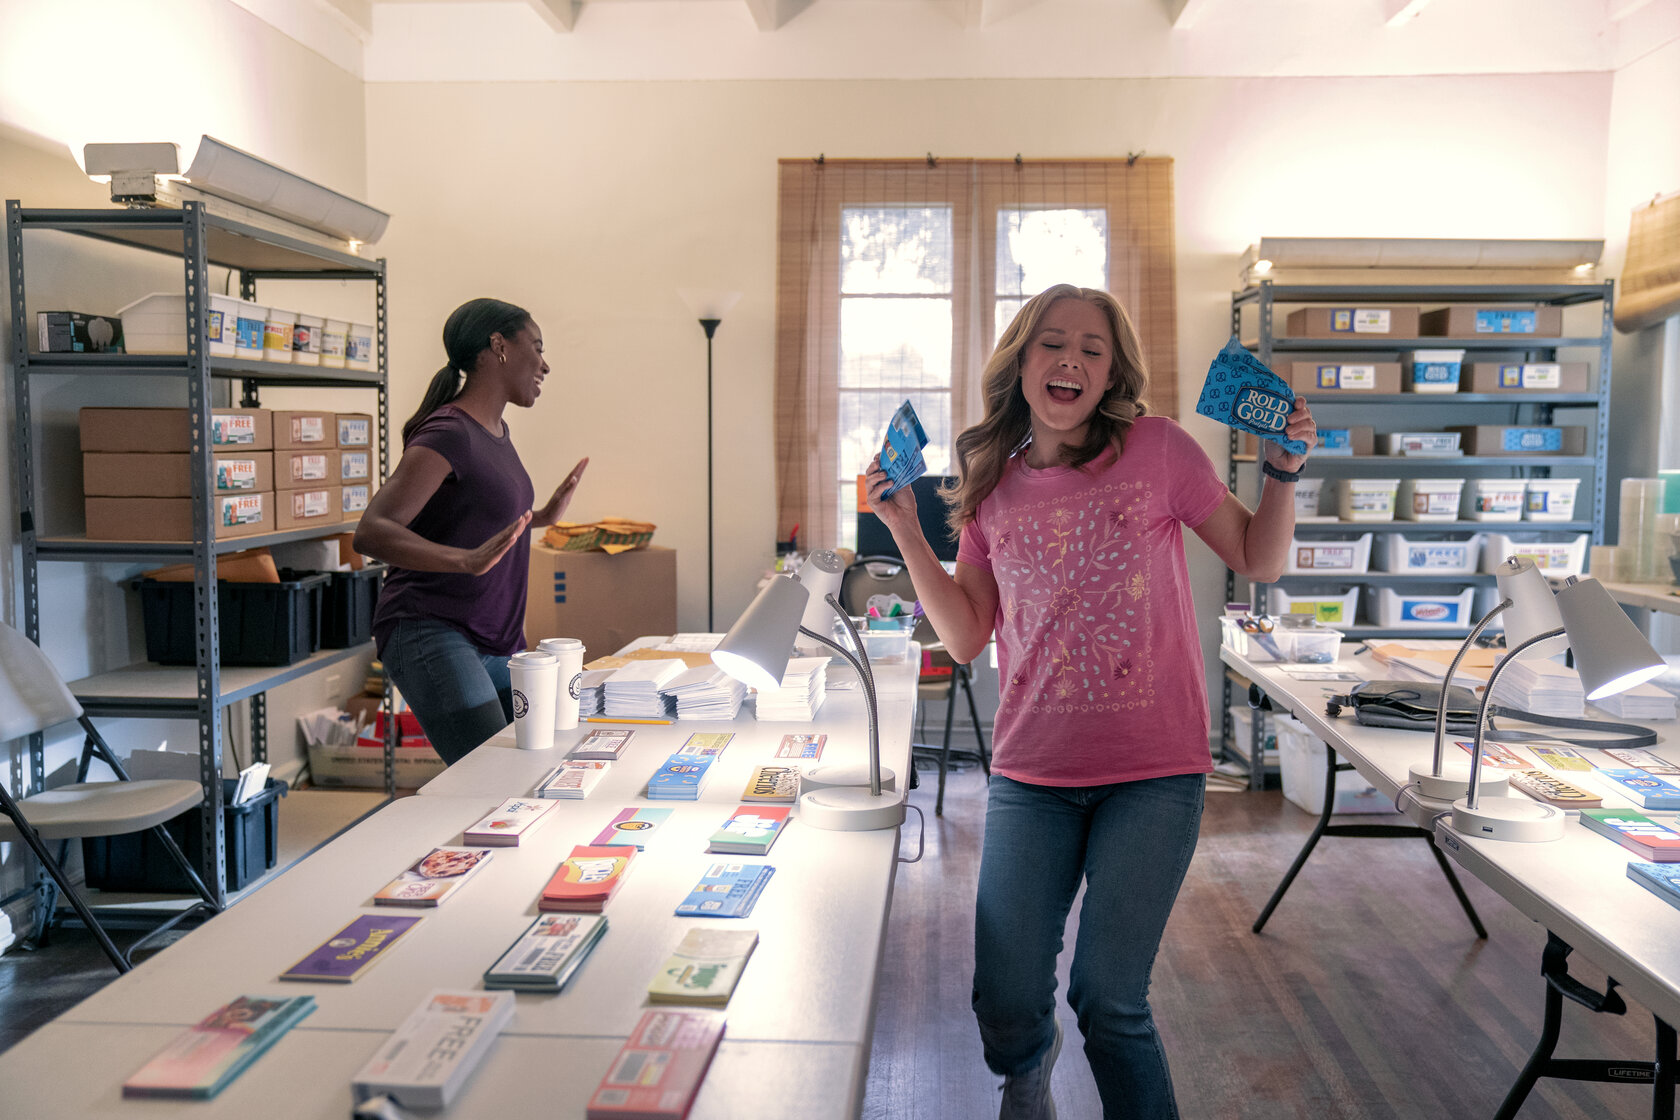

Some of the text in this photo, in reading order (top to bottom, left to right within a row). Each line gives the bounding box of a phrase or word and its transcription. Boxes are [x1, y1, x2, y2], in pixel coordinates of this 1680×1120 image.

[1247, 389, 1289, 415] ROLD
[230, 419, 252, 428] FREE
[1237, 402, 1287, 431] GOLD
[233, 464, 253, 473] FREE
[238, 499, 259, 509] FREE
[753, 766, 792, 795] Cheerios
[725, 878, 753, 899] FREE
[336, 928, 394, 960] Annie's
[428, 1015, 482, 1060] FREE
[1613, 1069, 1651, 1077] LIFETIME
